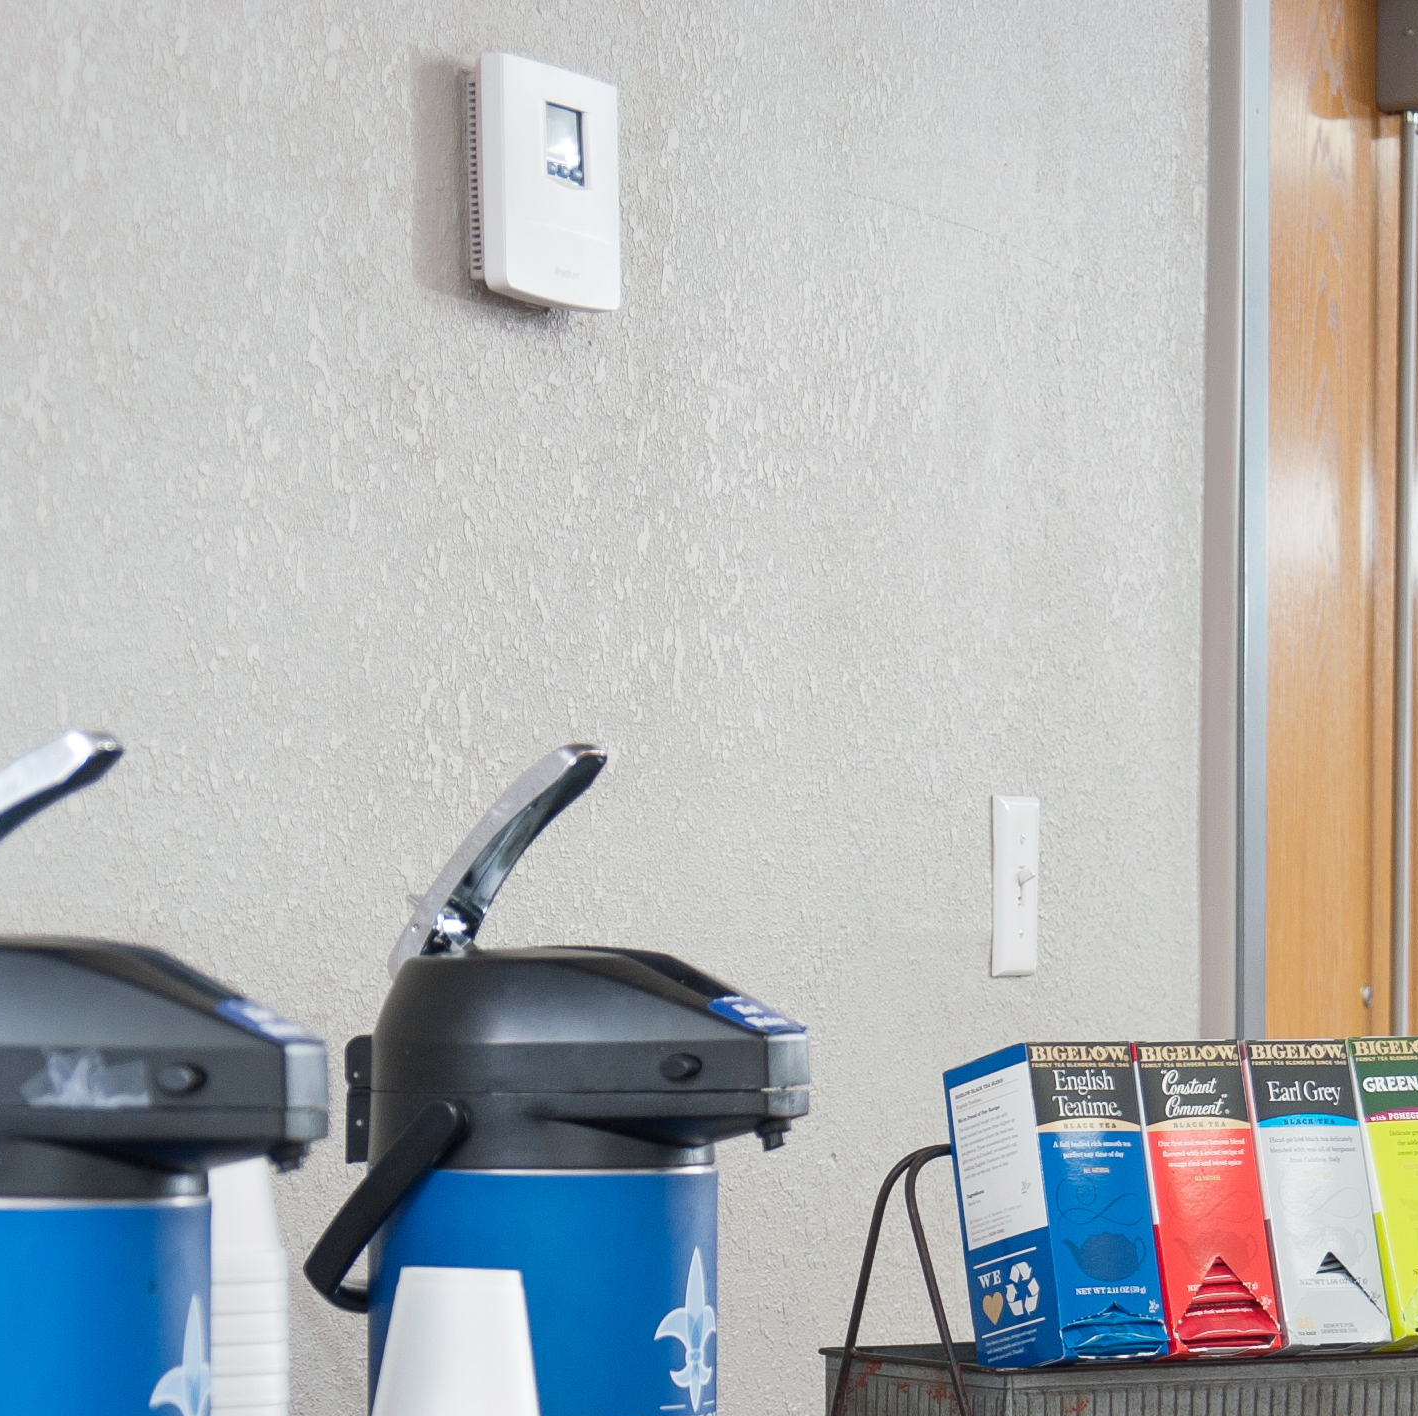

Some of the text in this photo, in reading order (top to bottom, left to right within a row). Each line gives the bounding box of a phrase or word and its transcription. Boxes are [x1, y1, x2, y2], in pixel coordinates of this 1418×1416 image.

[1029, 1045, 1127, 1062] BIGELOW
[1138, 1045, 1237, 1062] BIGELOW
[1249, 1044, 1344, 1060] BIGELOW
[1052, 1069, 1115, 1095] English
[1266, 1080, 1341, 1106] Earl Grey
[1052, 1095, 1118, 1117] Teatime
[978, 1270, 1001, 1289] WE
[1075, 1287, 1092, 1295] NET
[1092, 1287, 1106, 1295] WT
